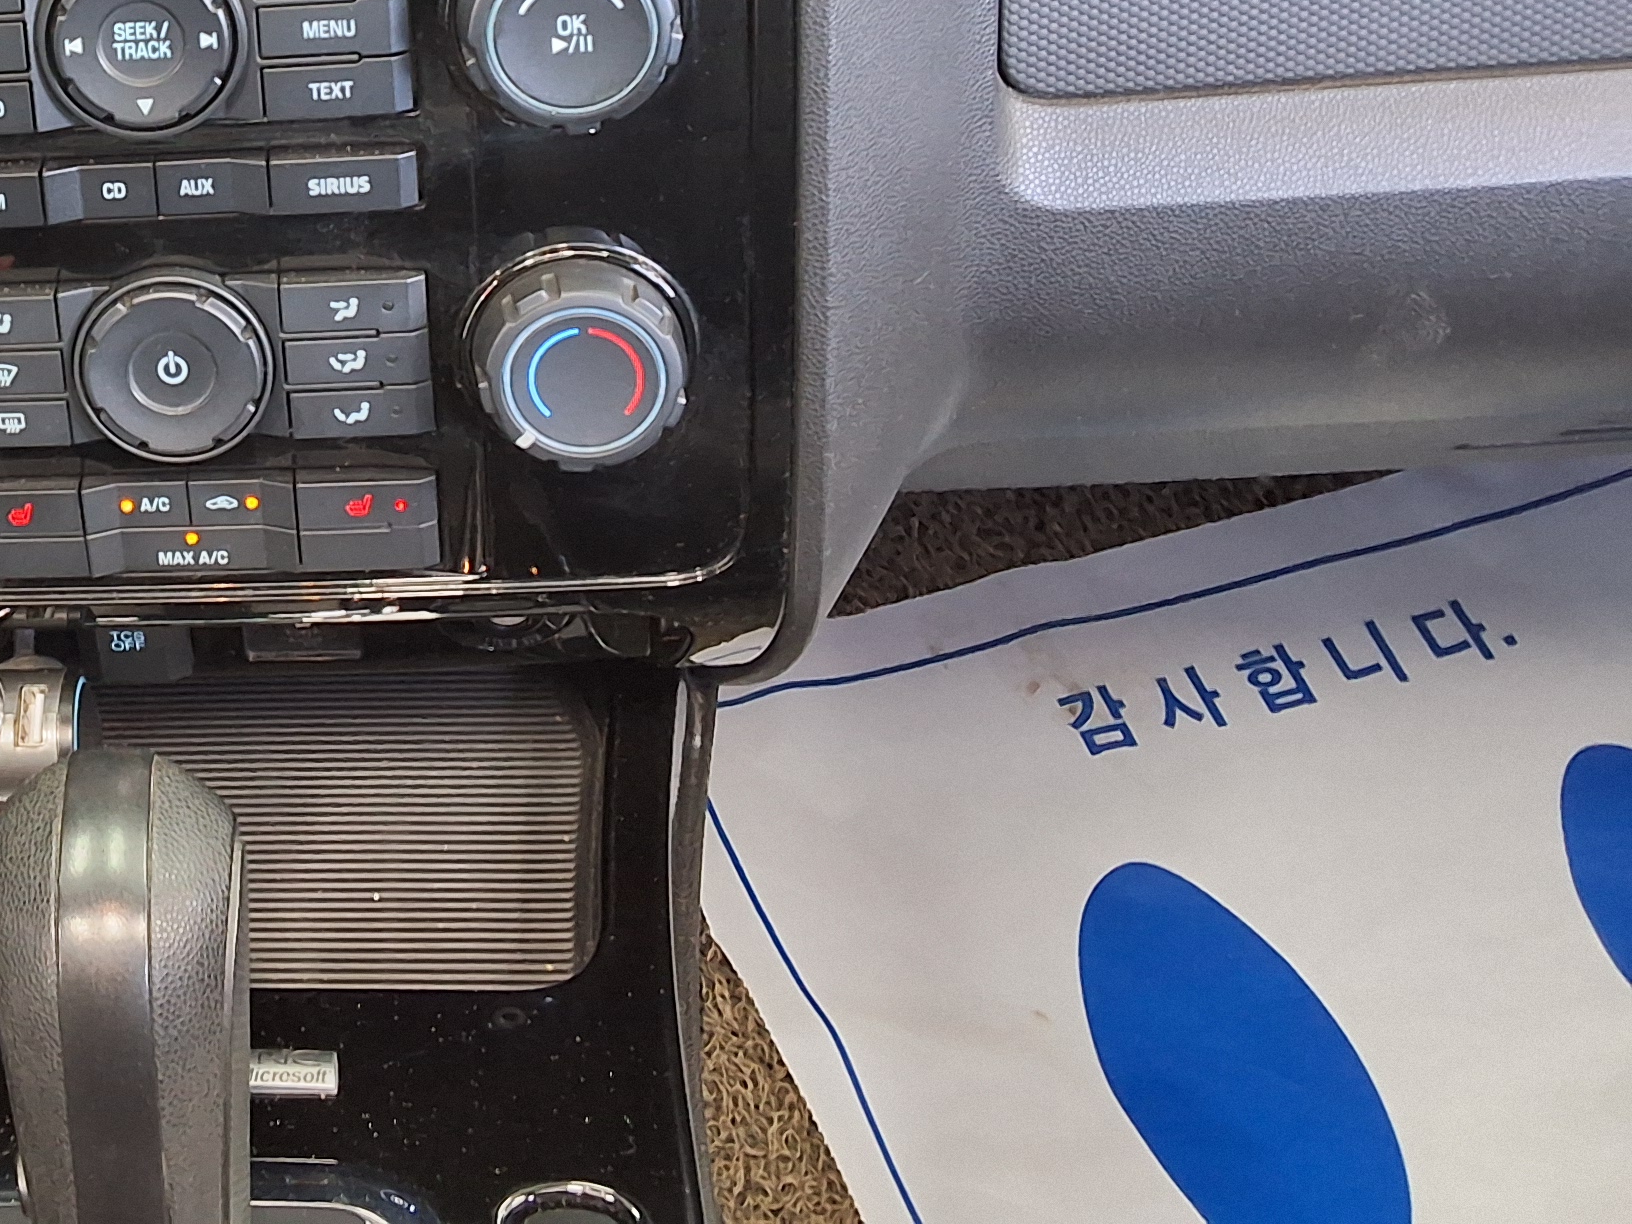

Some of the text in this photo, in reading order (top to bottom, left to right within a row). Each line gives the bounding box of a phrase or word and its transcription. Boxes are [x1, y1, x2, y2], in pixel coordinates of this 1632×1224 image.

[302, 18, 356, 39] MENU
[556, 14, 587, 36] OK
[112, 40, 171, 61] TRACK
[308, 80, 354, 101] TEXT
[101, 181, 126, 200] CD
[179, 177, 214, 197] AUX
[307, 175, 371, 196] SIRIUS
[140, 497, 171, 513] A/C
[158, 549, 229, 566] MAX A/C
[111, 640, 145, 652] OFF
[1056, 598, 1518, 756] 감사합니다.
